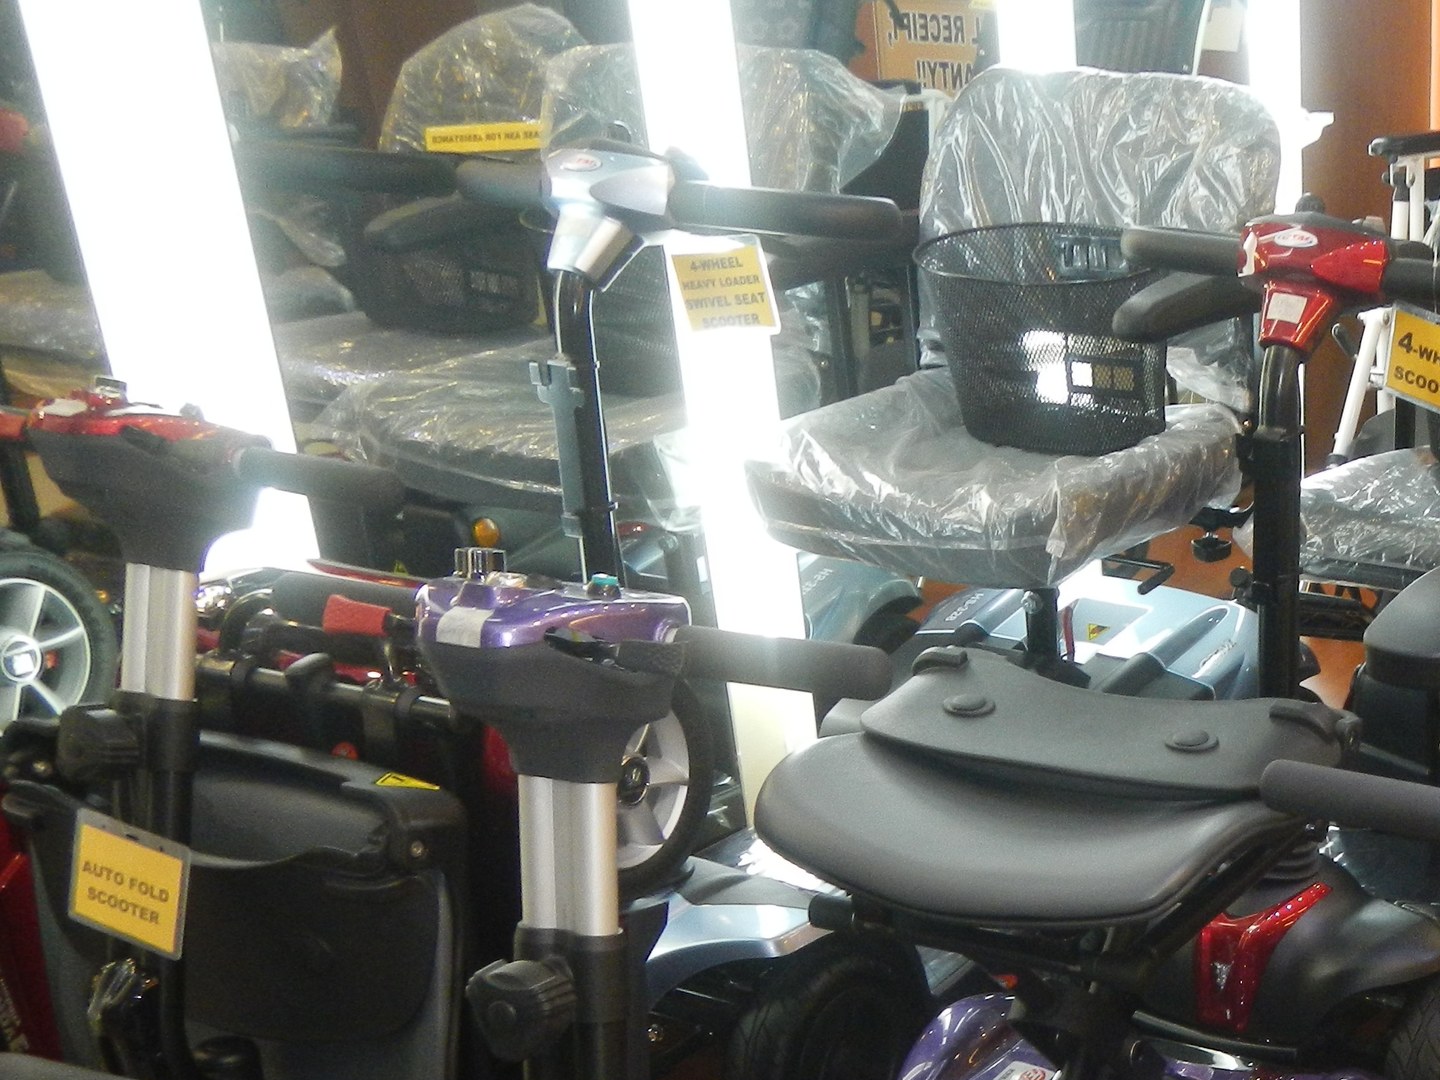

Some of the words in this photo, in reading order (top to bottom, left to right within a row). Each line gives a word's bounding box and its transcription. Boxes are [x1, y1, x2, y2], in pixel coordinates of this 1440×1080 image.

[690, 257, 743, 272] 4-WHEEL
[682, 279, 716, 290] HEAVY
[719, 275, 760, 287] LOADER
[685, 296, 731, 310] SWIVEL
[735, 292, 765, 305] SEAT
[702, 313, 760, 328] SCOOTER
[82, 861, 124, 886] AUTO
[129, 877, 169, 902] FOLD
[87, 886, 160, 924] SCOOTER
